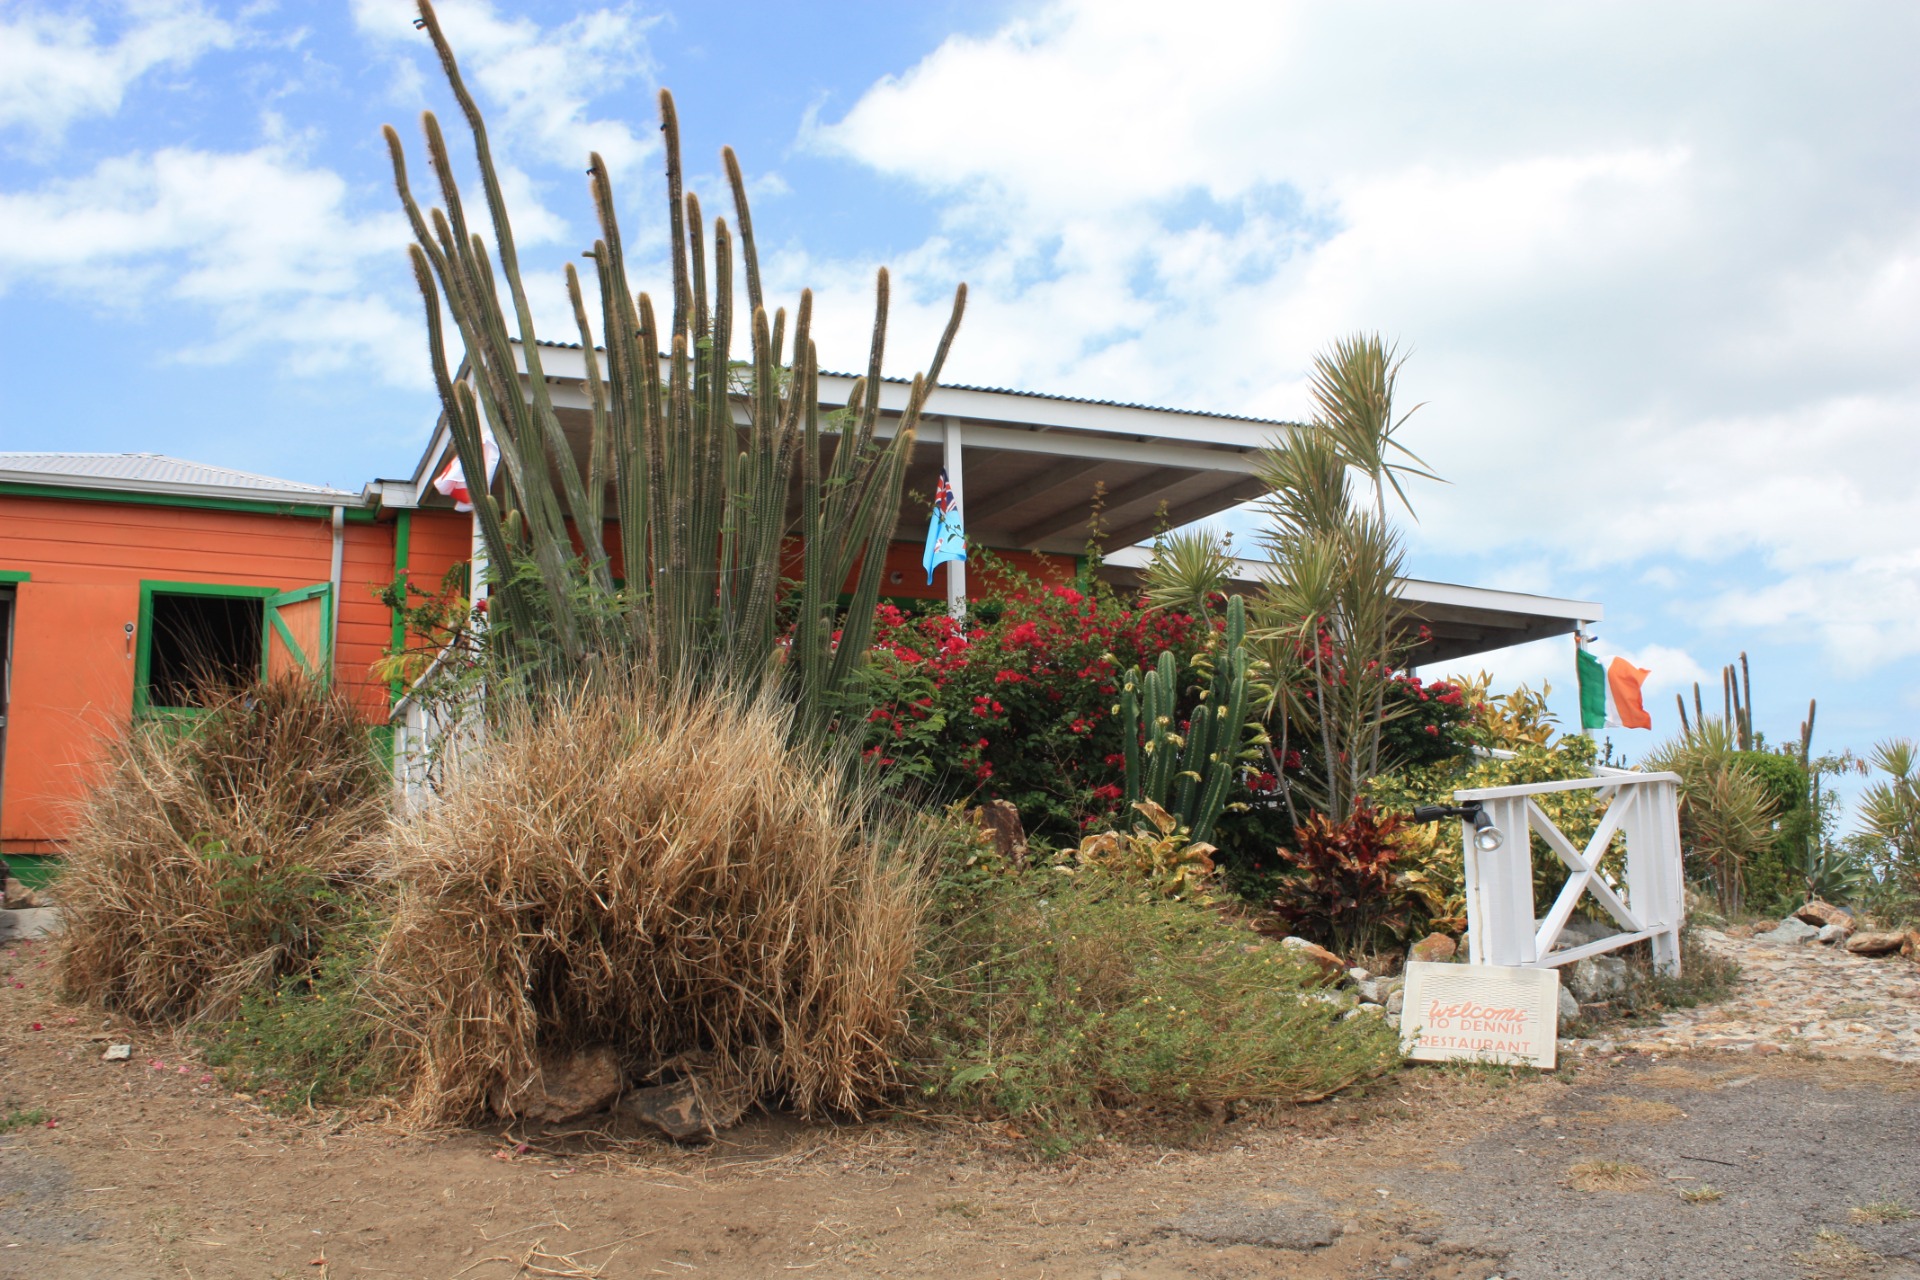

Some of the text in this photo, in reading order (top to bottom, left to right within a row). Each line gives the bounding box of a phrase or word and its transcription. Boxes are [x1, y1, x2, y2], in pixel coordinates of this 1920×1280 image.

[1428, 999, 1529, 1023] Welcome
[1429, 1017, 1523, 1036] TO DENNIS
[1418, 1035, 1531, 1053] RESTAURANT
